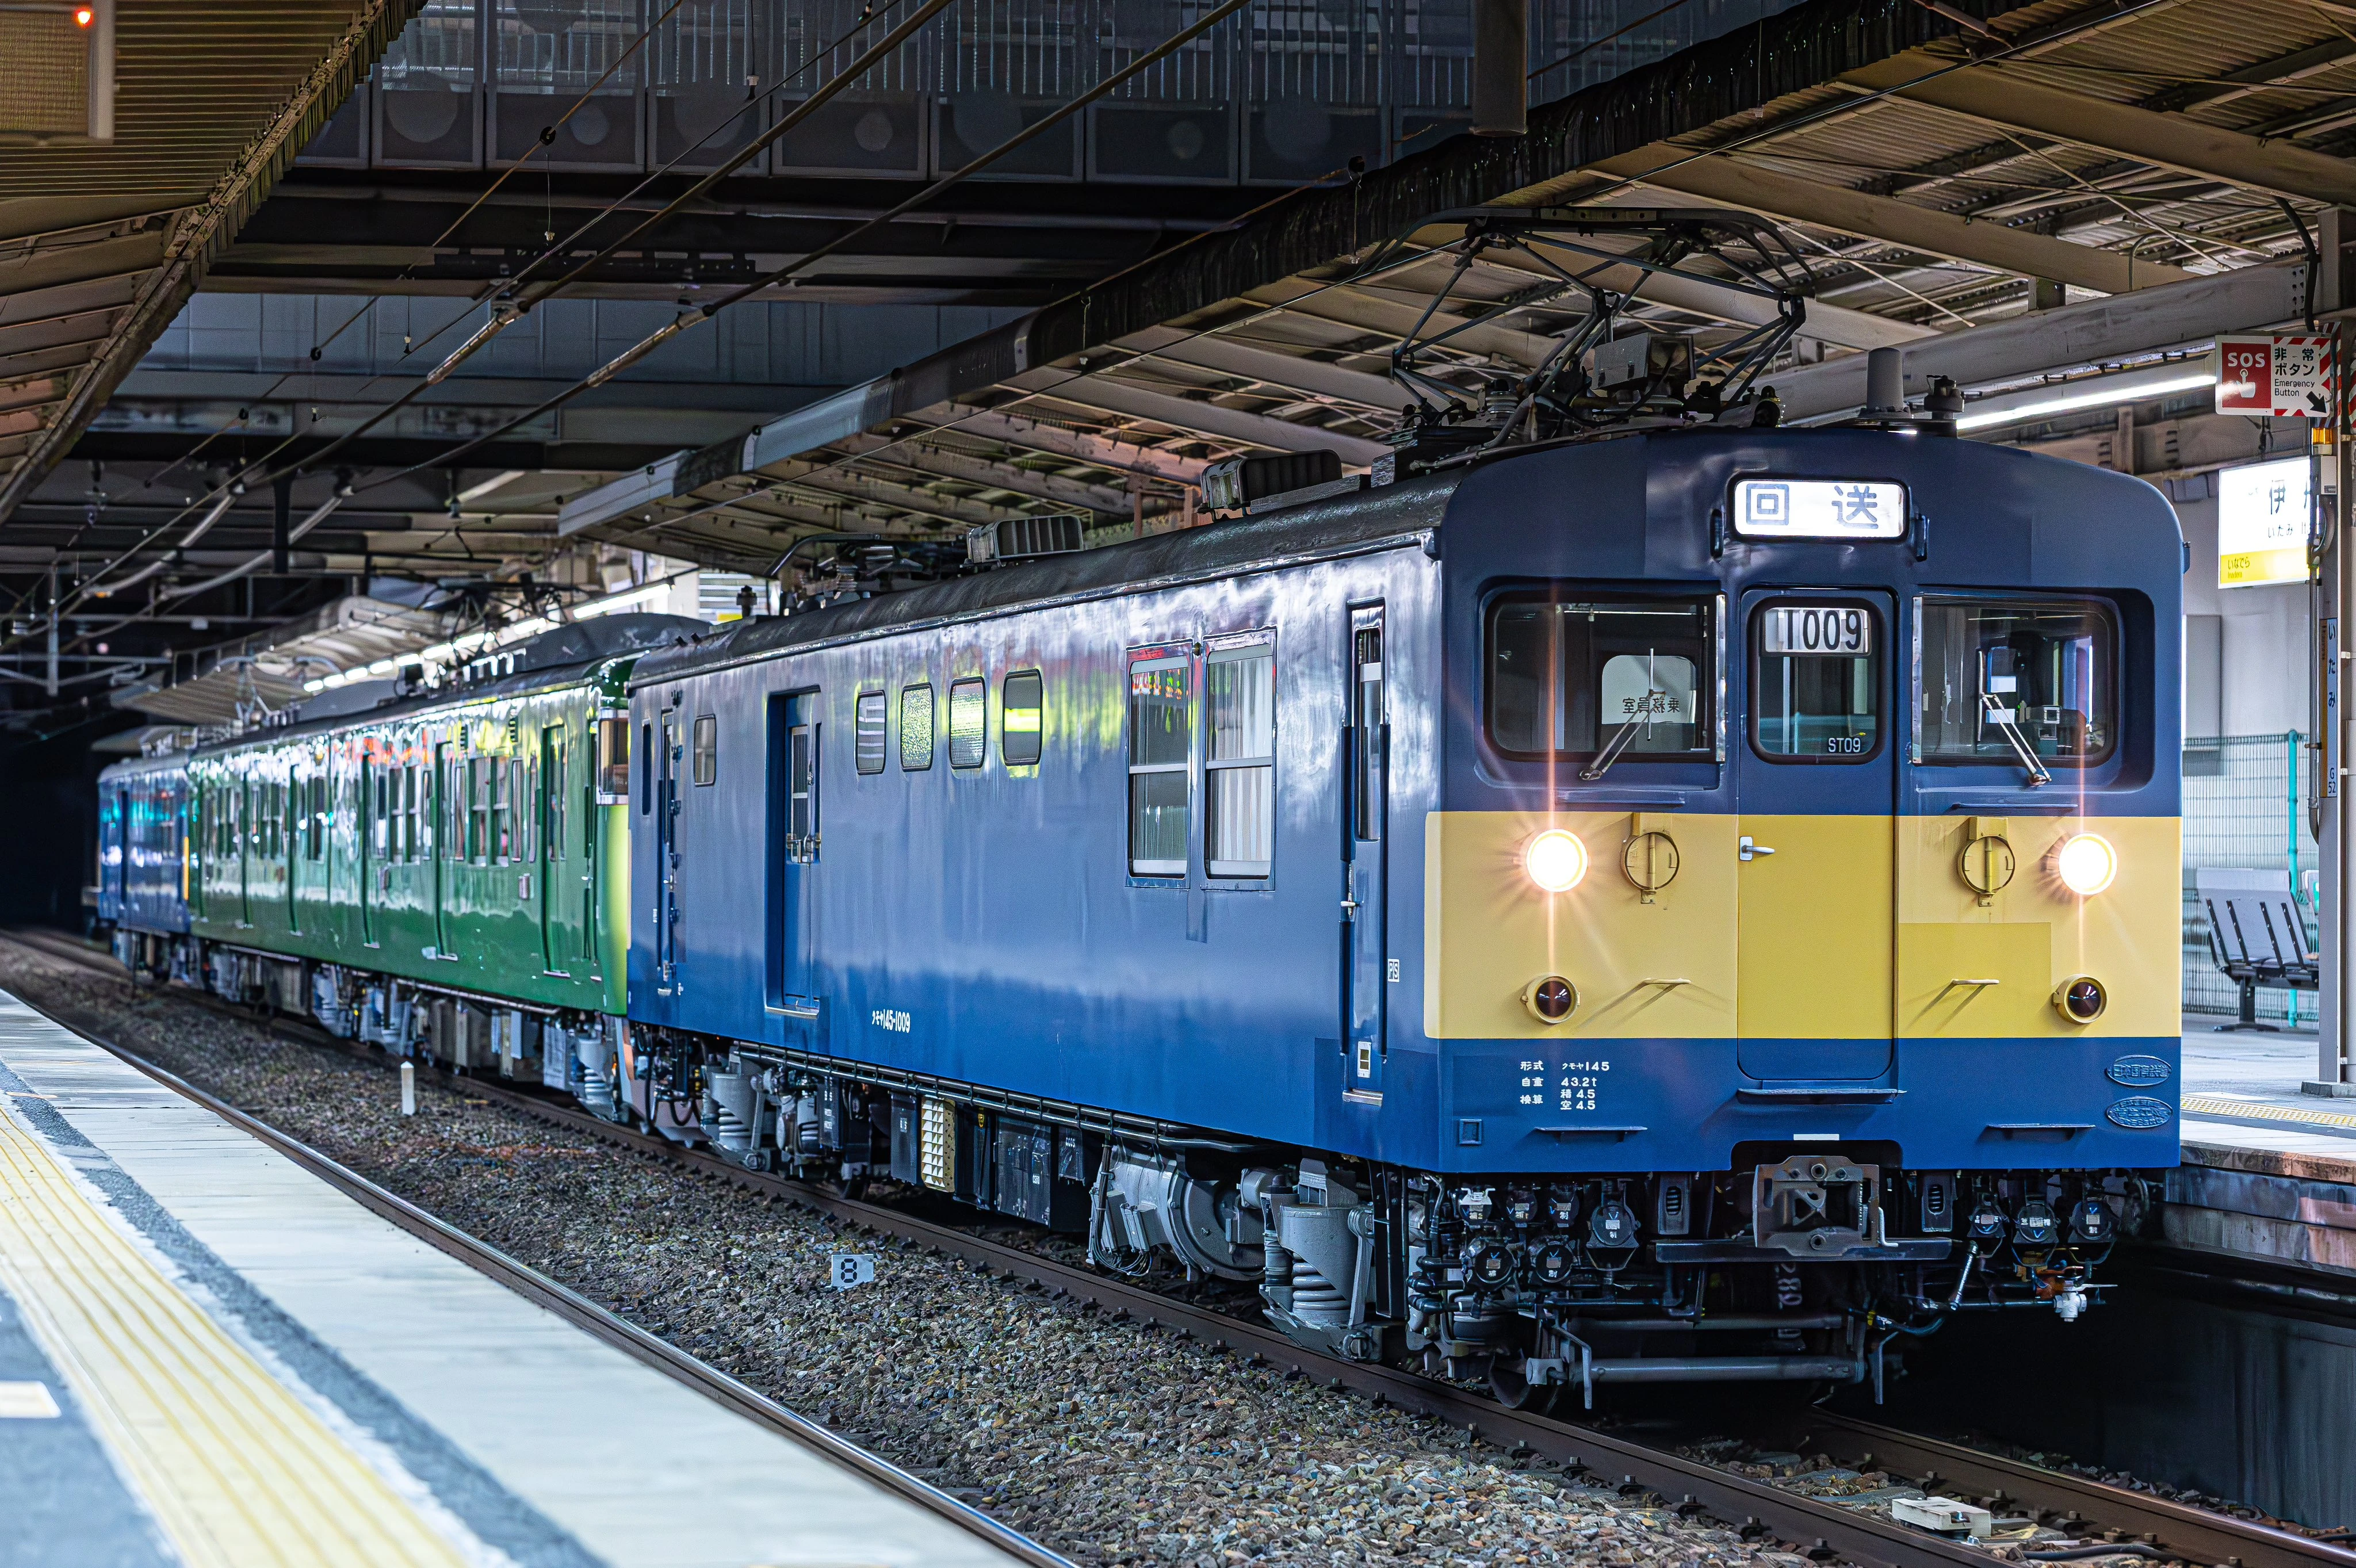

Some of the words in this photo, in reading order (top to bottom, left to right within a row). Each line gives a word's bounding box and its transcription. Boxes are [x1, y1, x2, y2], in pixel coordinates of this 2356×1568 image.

[2228, 352, 2265, 368] SOS
[2274, 347, 2314, 362] 非常
[2275, 363, 2314, 376] ボタン
[2274, 378, 2315, 388] Emergency
[2274, 388, 2300, 397] Button
[1746, 483, 1879, 529] 回送
[2268, 524, 2293, 538] いたみ
[2228, 557, 2250, 569] いなでら
[1787, 610, 1862, 651] 1009
[1828, 737, 1861, 752] ST09
[2330, 767, 2335, 779] G
[2328, 782, 2336, 794] 52
[1520, 1060, 1544, 1071] 形式
[1562, 1061, 1610, 1071] クモヤ145
[1521, 1077, 1544, 1087] 自重
[1561, 1077, 1597, 1087] 43.2t
[1576, 1089, 1596, 1099] 4.5
[1560, 1100, 1572, 1110] 空
[1575, 1100, 1596, 1110] 4.5
[840, 1258, 858, 1284] 8
